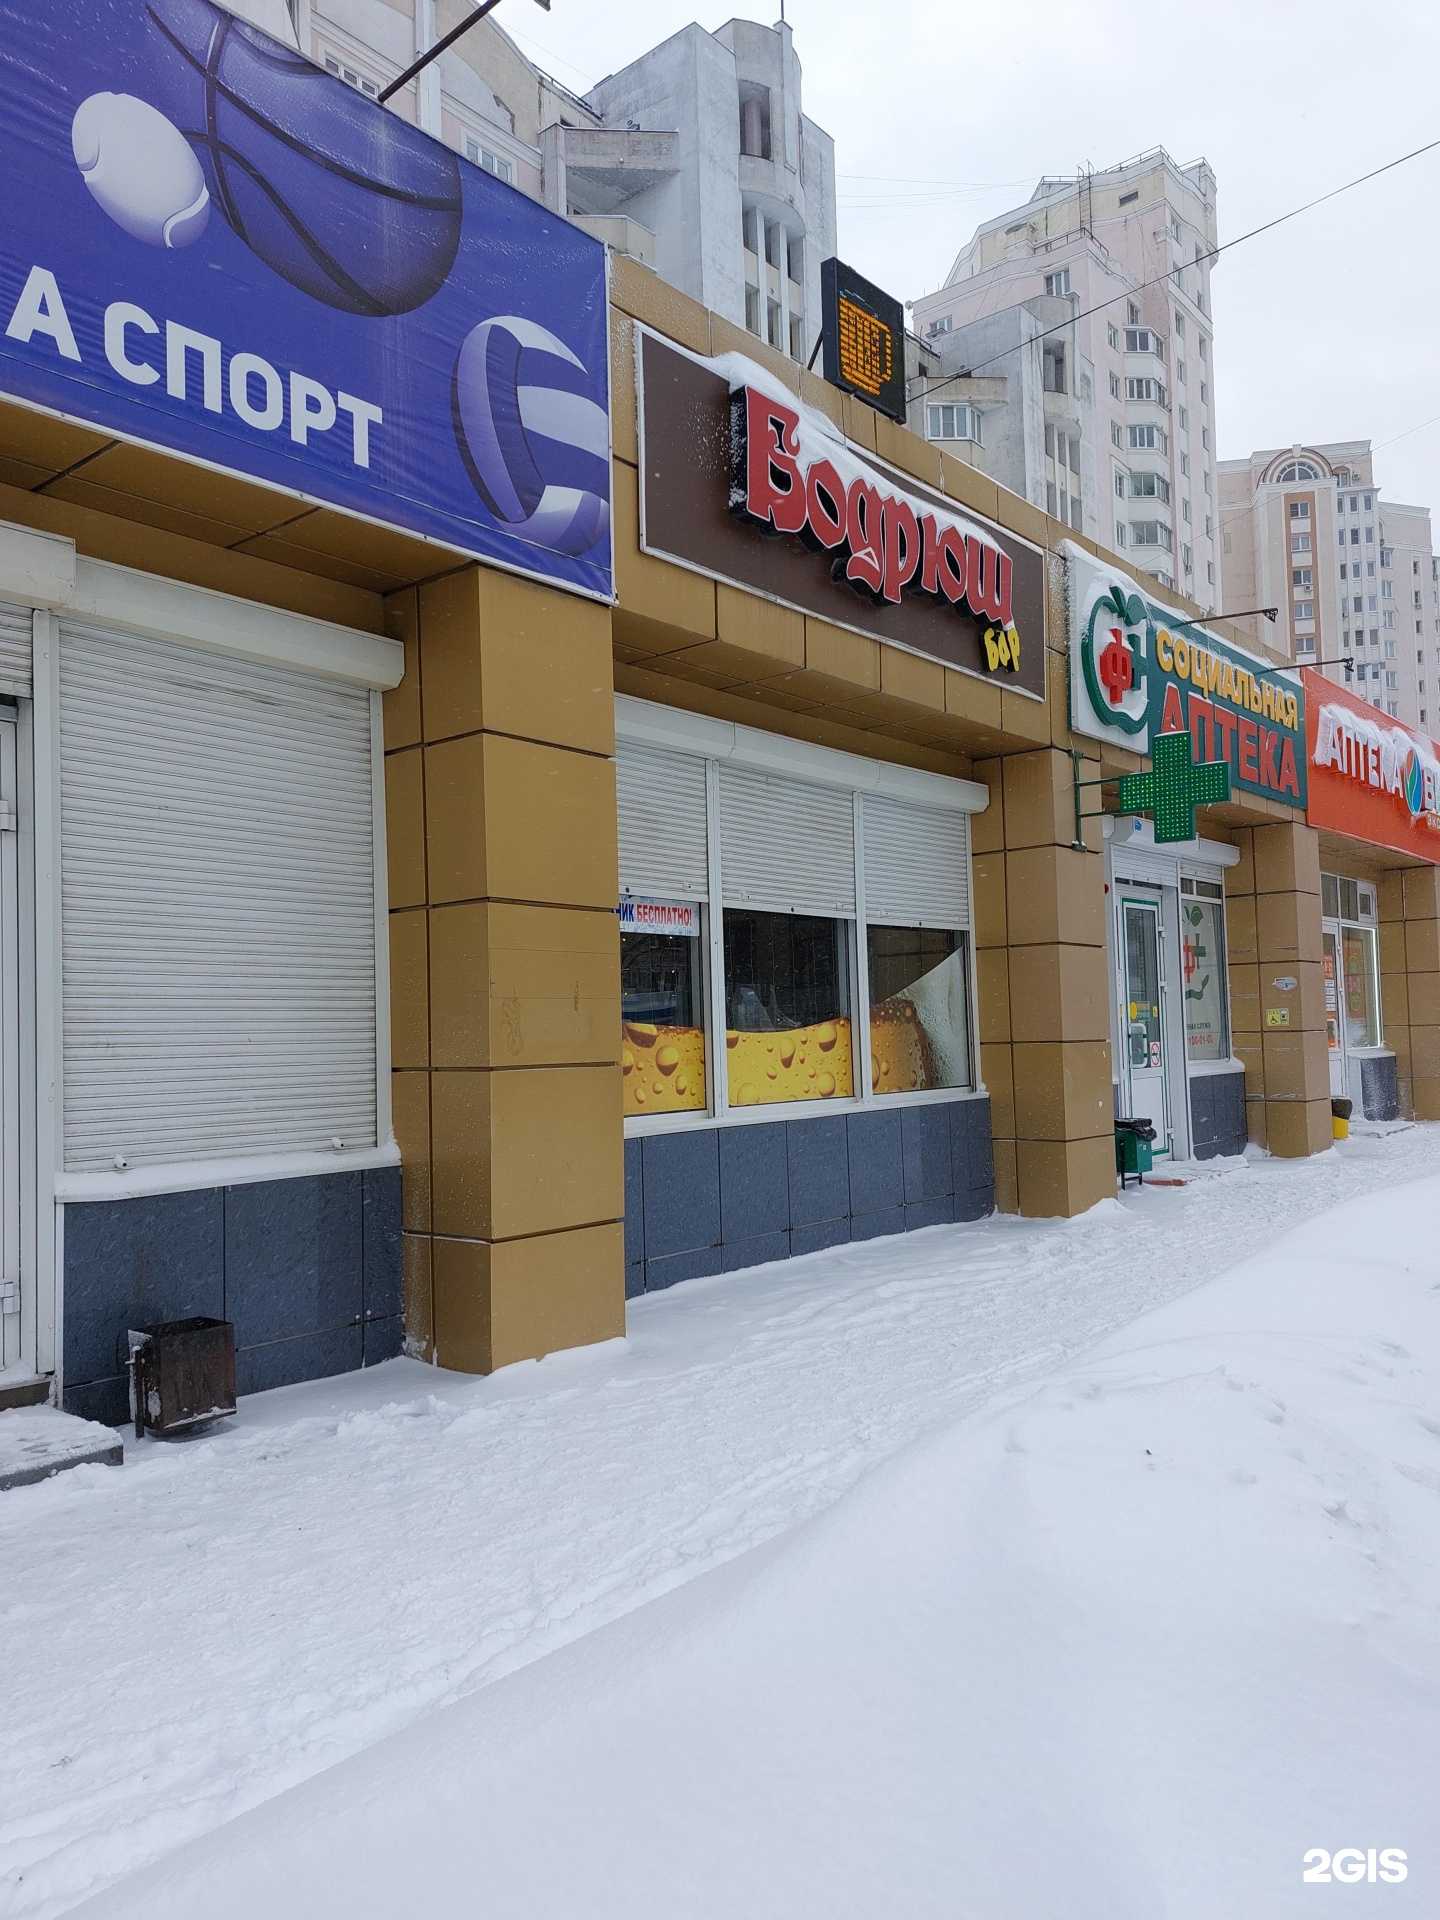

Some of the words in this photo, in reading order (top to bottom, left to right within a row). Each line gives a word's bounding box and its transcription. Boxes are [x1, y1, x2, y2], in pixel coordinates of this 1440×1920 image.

[5, 265, 82, 362] А
[103, 301, 383, 468] СПОРТ
[1156, 627, 1298, 732] СОЦИАЛЬНАЯ
[1161, 682, 1299, 797] АПТЕКА
[636, 904, 692, 927] БЕСПЛАТНО!
